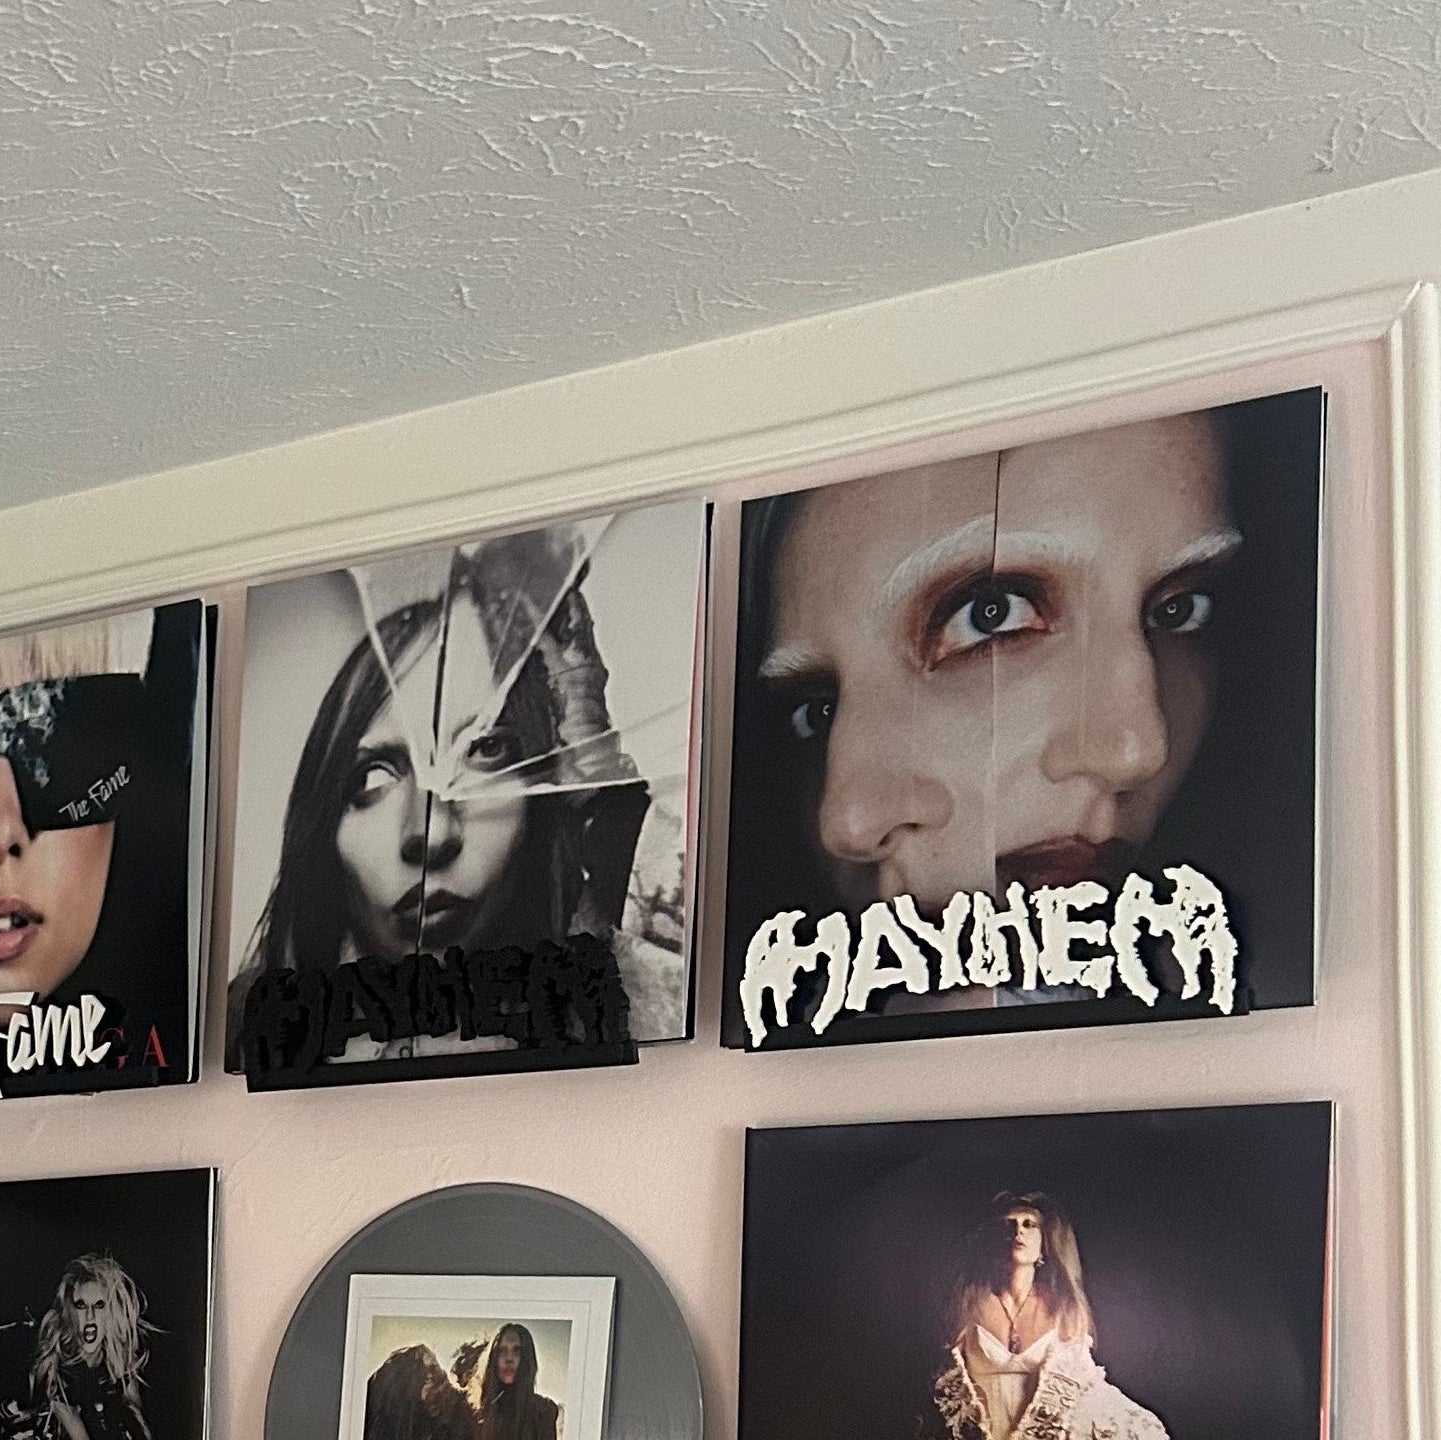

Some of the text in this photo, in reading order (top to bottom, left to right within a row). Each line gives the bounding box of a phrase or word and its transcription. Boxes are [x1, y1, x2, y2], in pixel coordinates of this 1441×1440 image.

[58, 765, 130, 821] The Fame
[740, 865, 1237, 1047] MAYHEM
